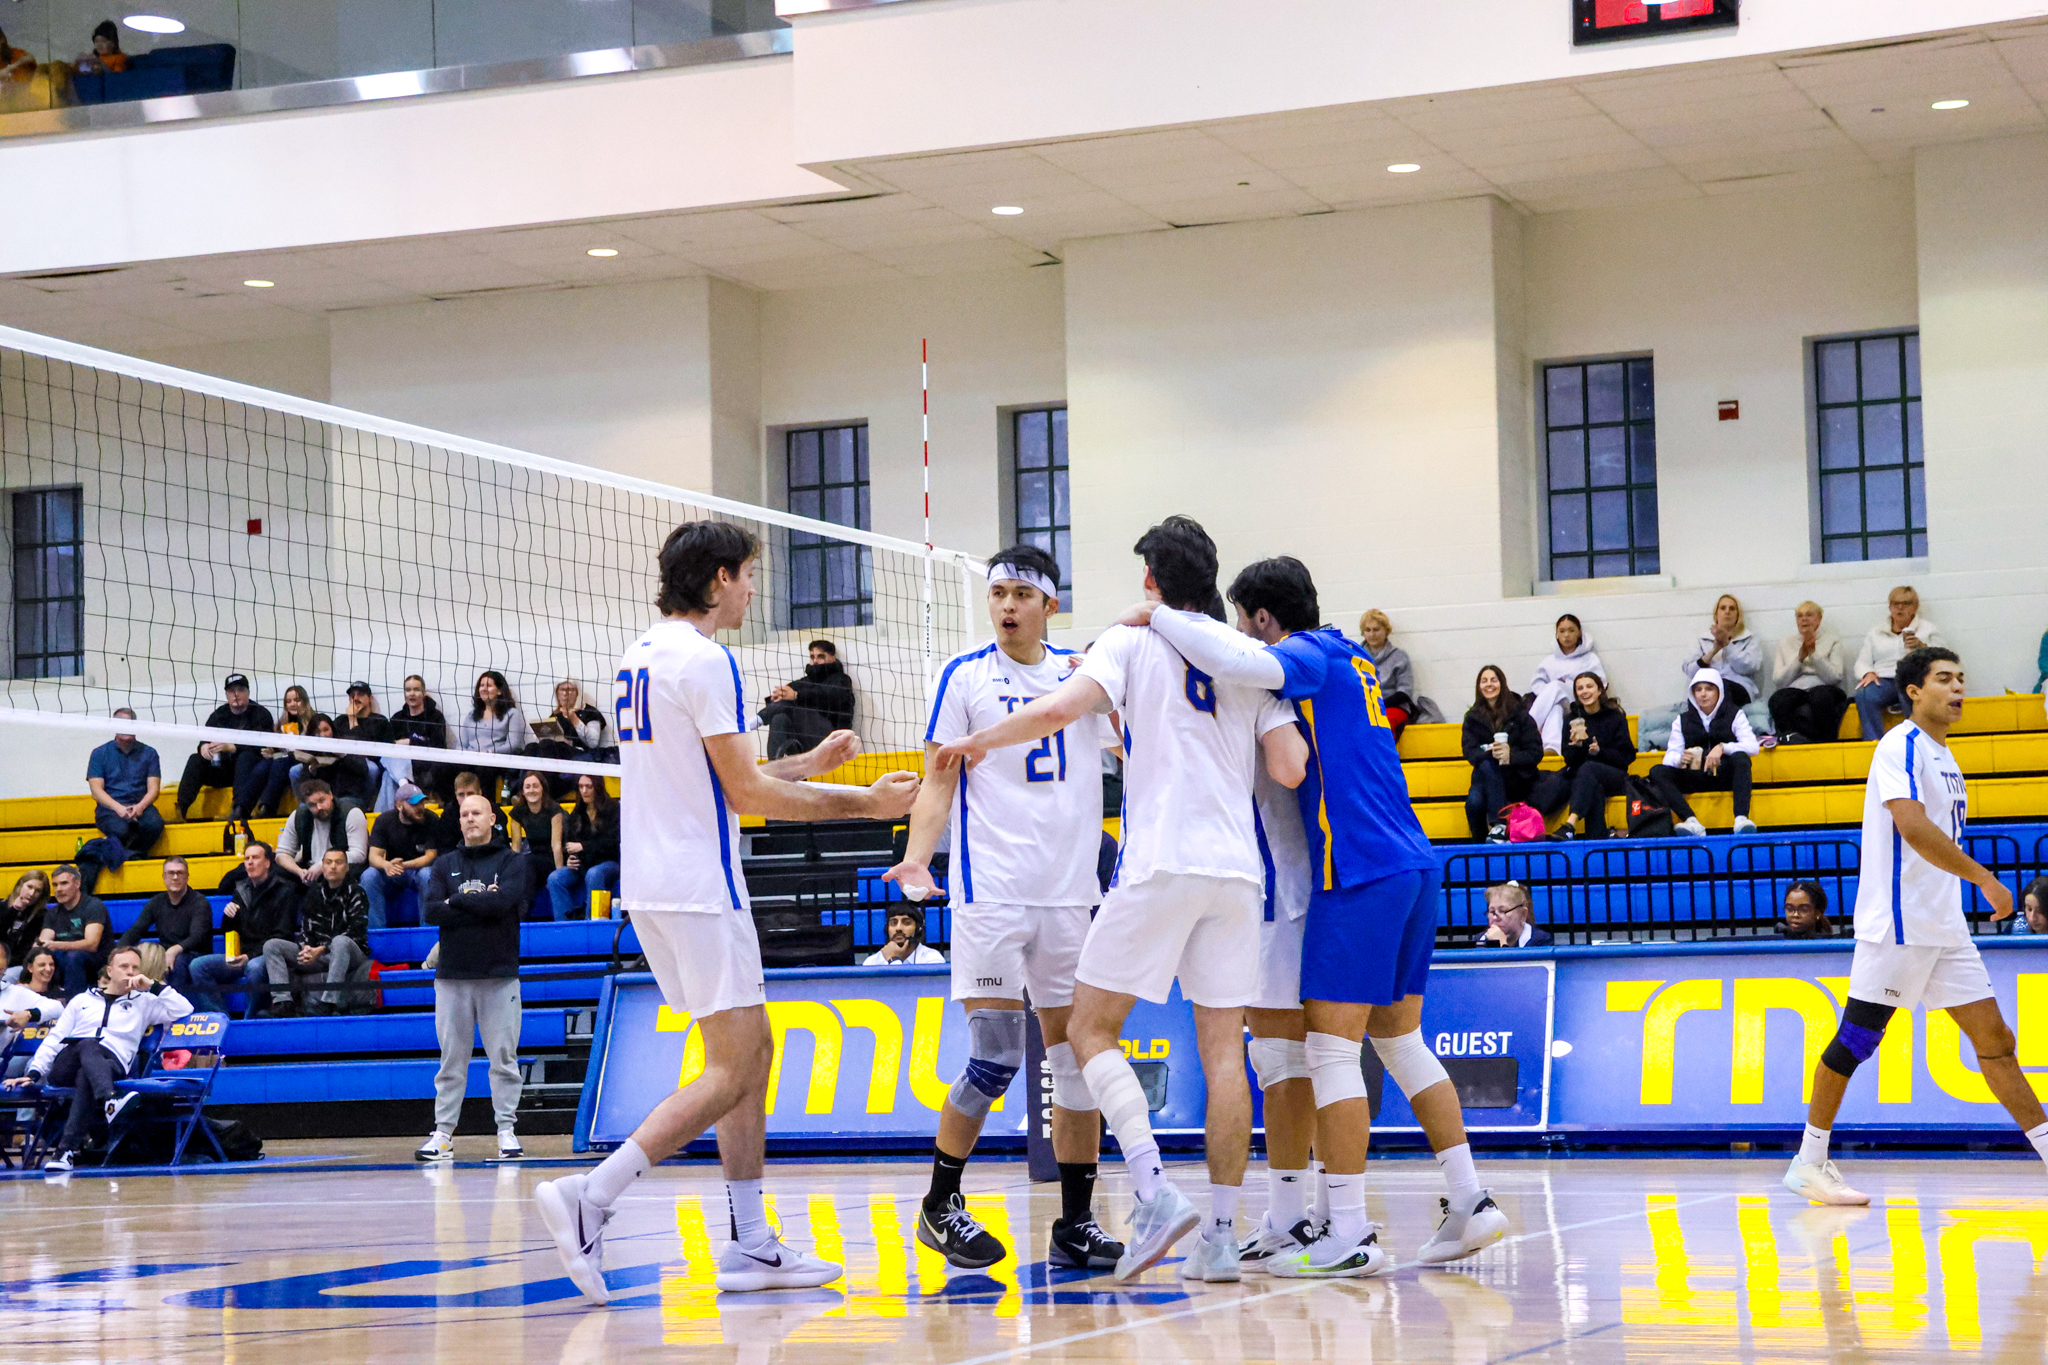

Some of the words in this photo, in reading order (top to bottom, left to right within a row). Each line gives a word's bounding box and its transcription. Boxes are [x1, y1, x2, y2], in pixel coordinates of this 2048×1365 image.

[615, 666, 653, 743] 20
[1024, 728, 1067, 783] 21
[975, 976, 1003, 987] TMU
[1884, 987, 1902, 998] TMU
[170, 1022, 220, 1037] BOLD
[1118, 1038, 1171, 1060] OLD
[1435, 1031, 1513, 1056] GUEST
